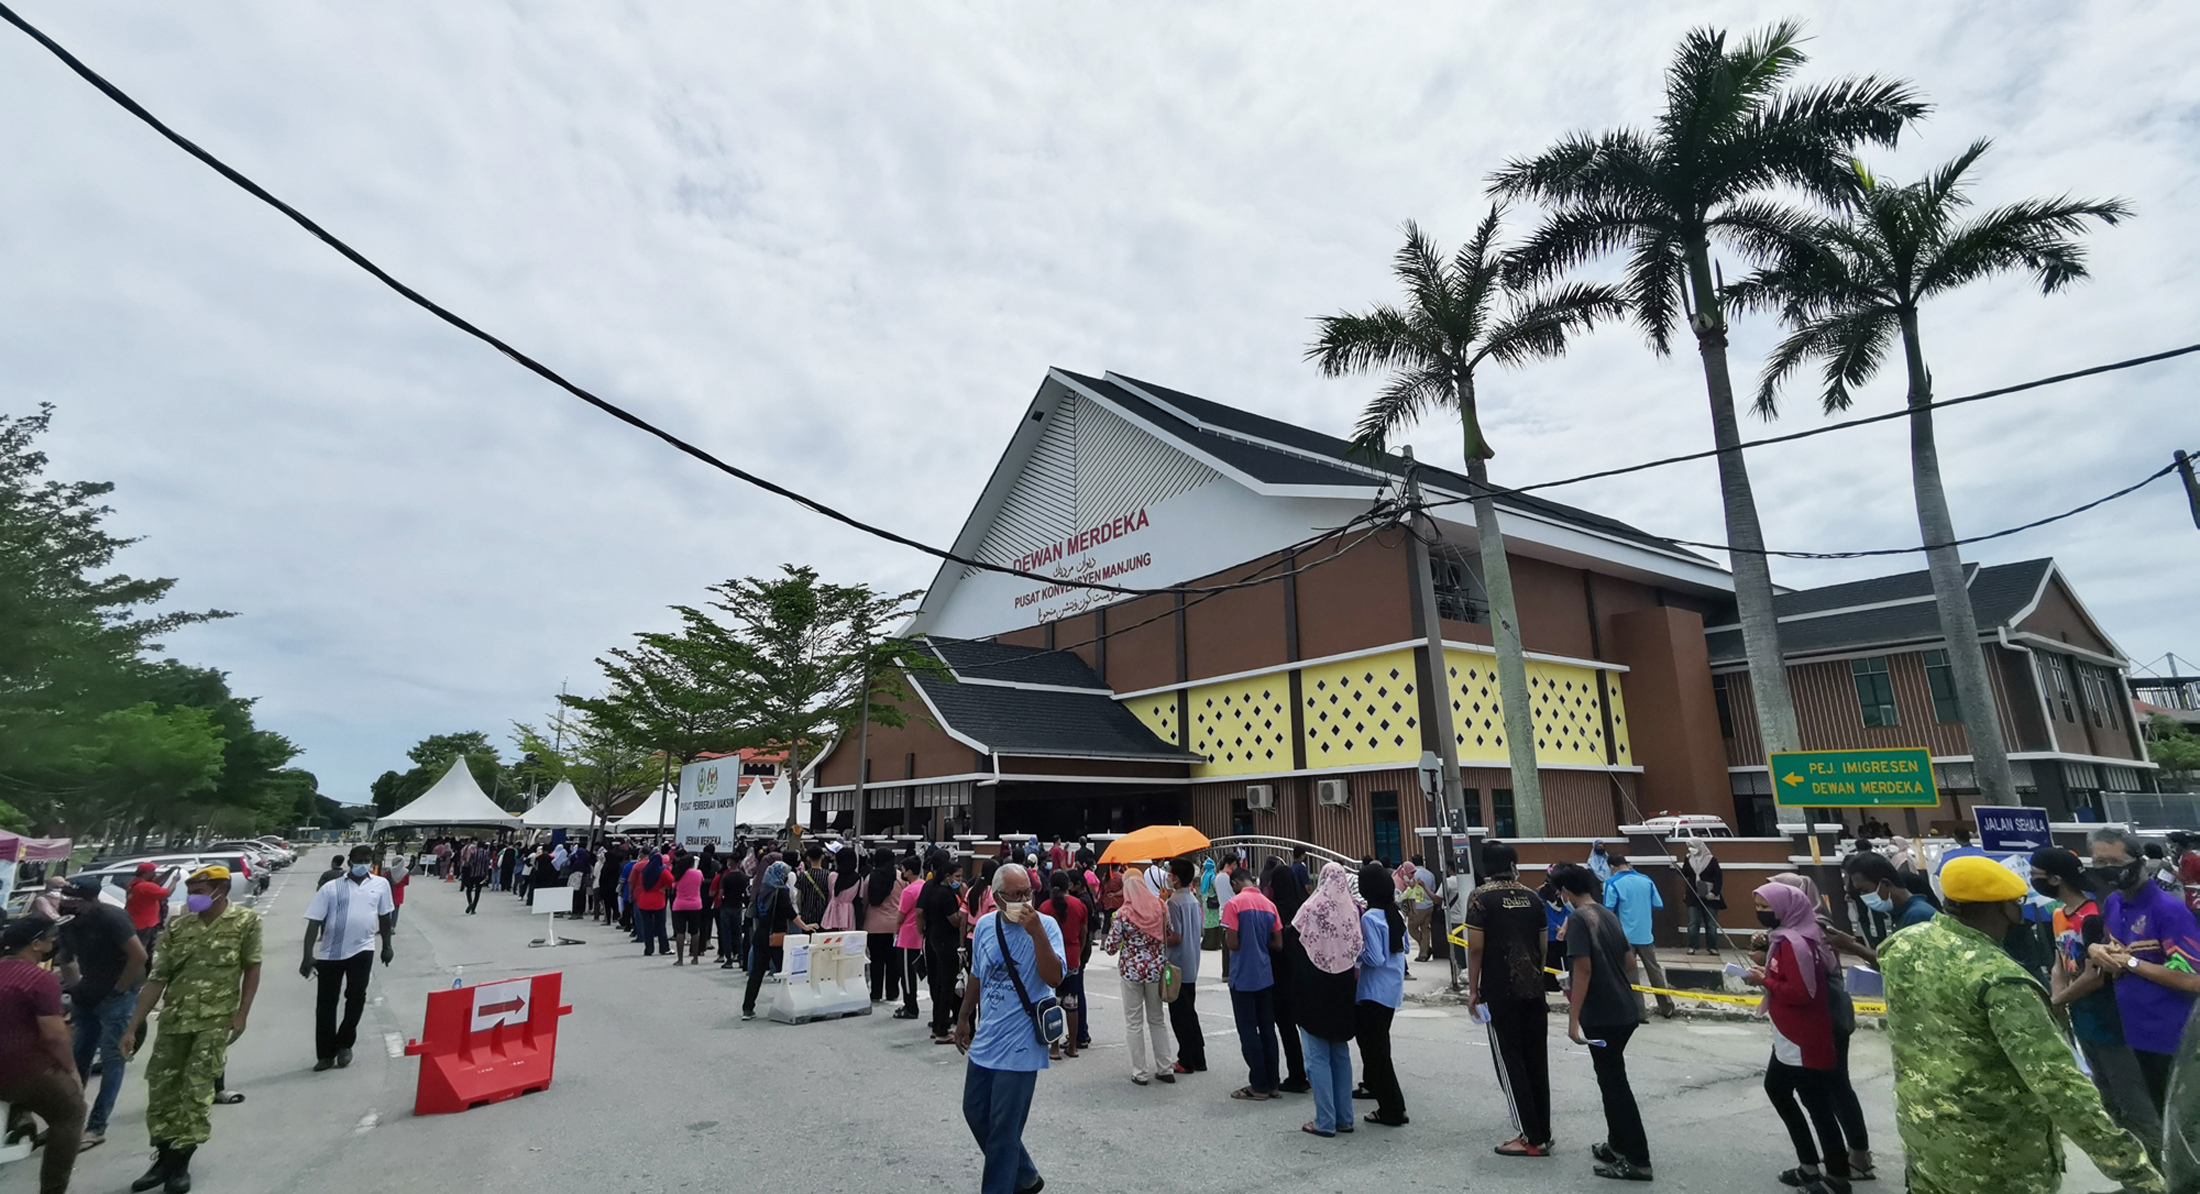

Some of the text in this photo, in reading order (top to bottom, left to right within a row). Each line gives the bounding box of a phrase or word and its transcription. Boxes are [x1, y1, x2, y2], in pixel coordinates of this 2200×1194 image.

[1013, 508, 1149, 576] DEWAN MERDEKA
[1014, 590, 1041, 609] PUSAT
[1102, 552, 1152, 580] MANJUNG
[1809, 760, 1918, 774] PEJ. IMIGRESEN
[1812, 781, 1924, 794] DEWAN MERDEKA
[717, 798, 735, 809] VAKSIN
[1984, 817, 2046, 832] JALAN SEHALA
